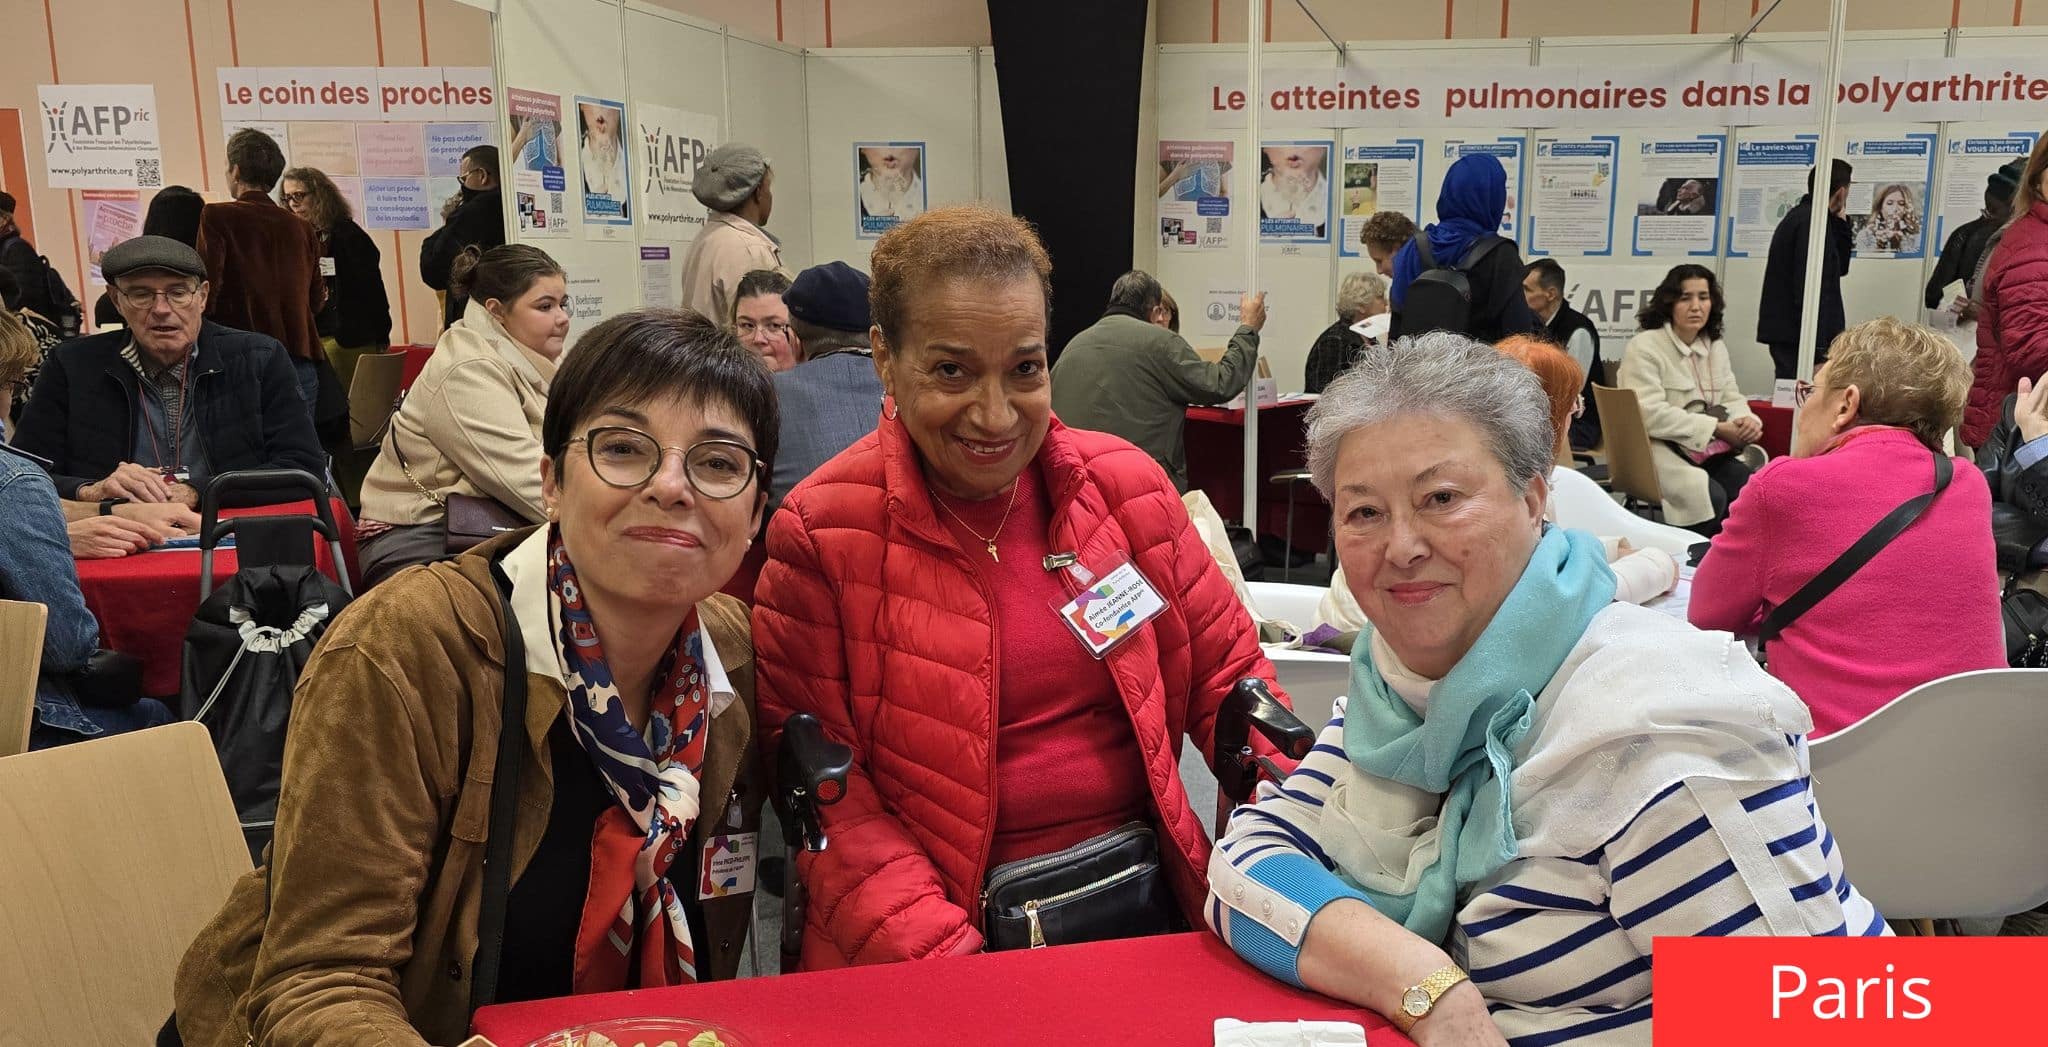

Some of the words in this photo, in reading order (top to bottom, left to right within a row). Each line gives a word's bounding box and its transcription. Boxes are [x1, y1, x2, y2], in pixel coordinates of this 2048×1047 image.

[225, 82, 252, 104] Le
[258, 79, 315, 104] coin
[320, 81, 369, 104] des
[382, 81, 493, 112] proches
[1213, 86, 1263, 110] Le
[1270, 82, 1420, 110] atteintes
[1445, 80, 1667, 117] pulmonaires
[1682, 80, 1770, 107] dans
[1777, 79, 1810, 106] la
[51, 166, 133, 177] www.polyarthrite.org
[397, 185, 420, 193] proche
[1261, 224, 1313, 232] PULMONAIRES
